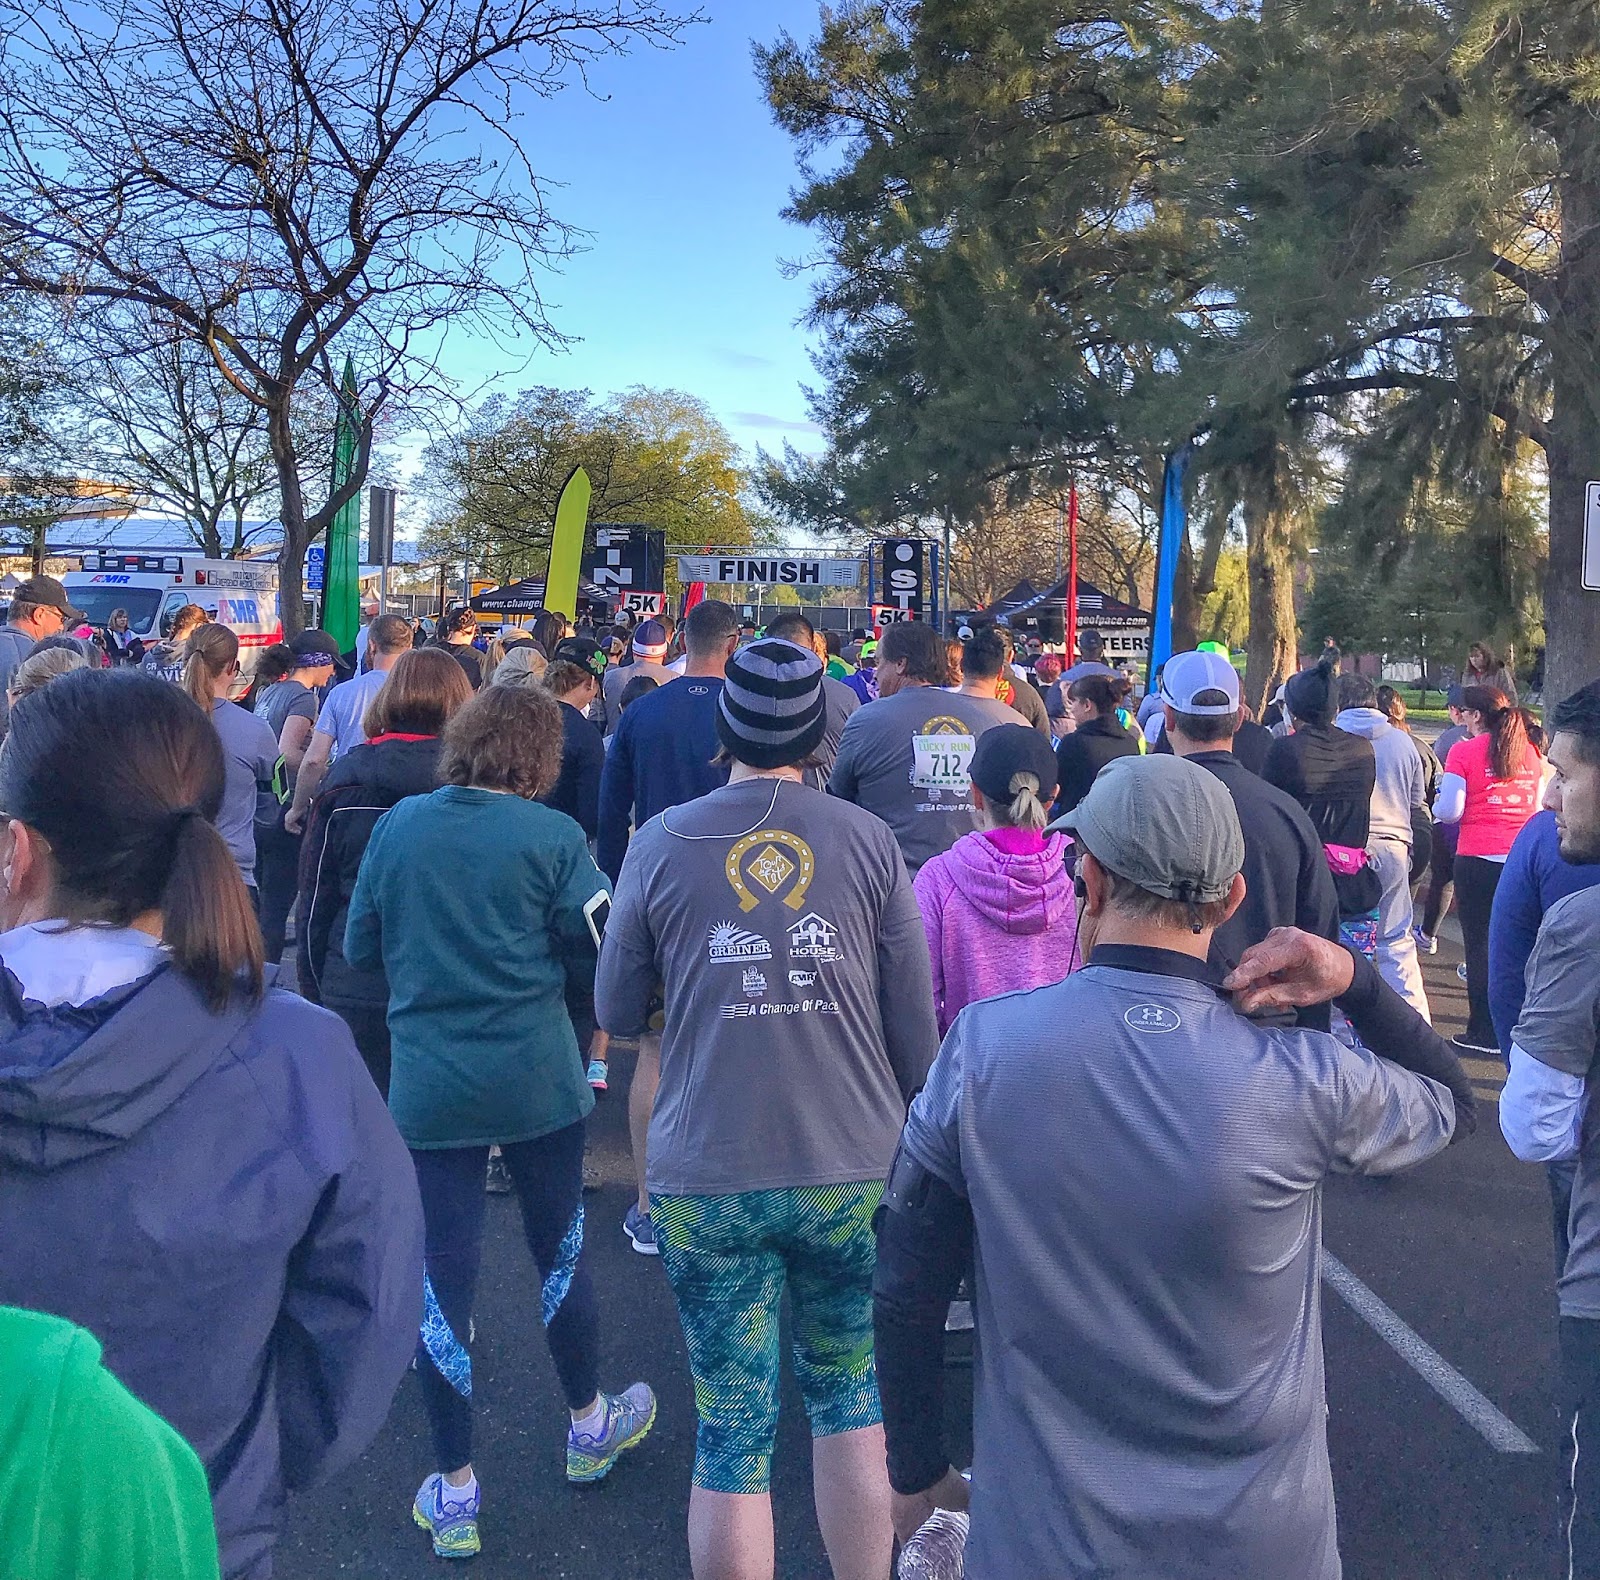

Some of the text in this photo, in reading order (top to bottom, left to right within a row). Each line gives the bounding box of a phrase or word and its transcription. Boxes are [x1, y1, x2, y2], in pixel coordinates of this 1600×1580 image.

[89, 574, 131, 584] AMR
[719, 560, 819, 583] FINISH
[628, 594, 656, 613] 5K
[219, 599, 260, 624] AMR
[879, 609, 906, 625] 5K
[918, 742, 971, 752] LUCKY RUN
[931, 753, 961, 777] 712
[792, 932, 836, 946] FIT
[709, 943, 771, 957] GREINER
[789, 947, 836, 955] HOUSE
[791, 973, 816, 982] AMR
[748, 999, 839, 1016] A Change Of Pace
